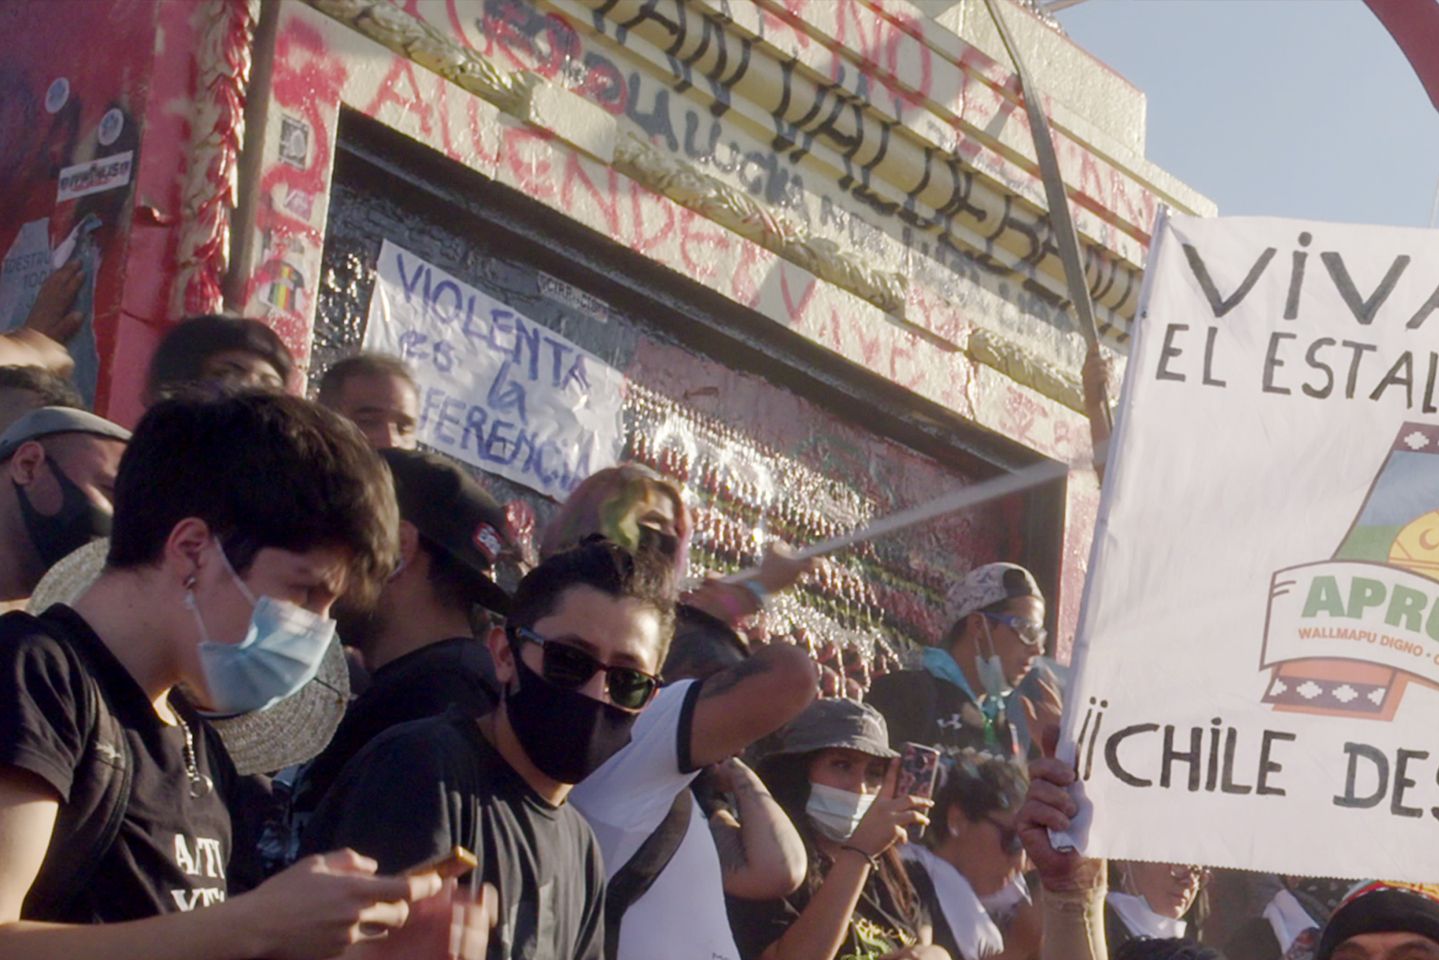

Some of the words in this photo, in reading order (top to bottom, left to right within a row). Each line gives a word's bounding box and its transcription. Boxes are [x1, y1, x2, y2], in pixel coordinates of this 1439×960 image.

[396, 253, 591, 390] VIOLENTA
[1156, 324, 1227, 388] EL
[418, 386, 591, 492] FERENCIA
[1298, 627, 1377, 645] WALLMAPU
[1379, 634, 1424, 657] DIGNO
